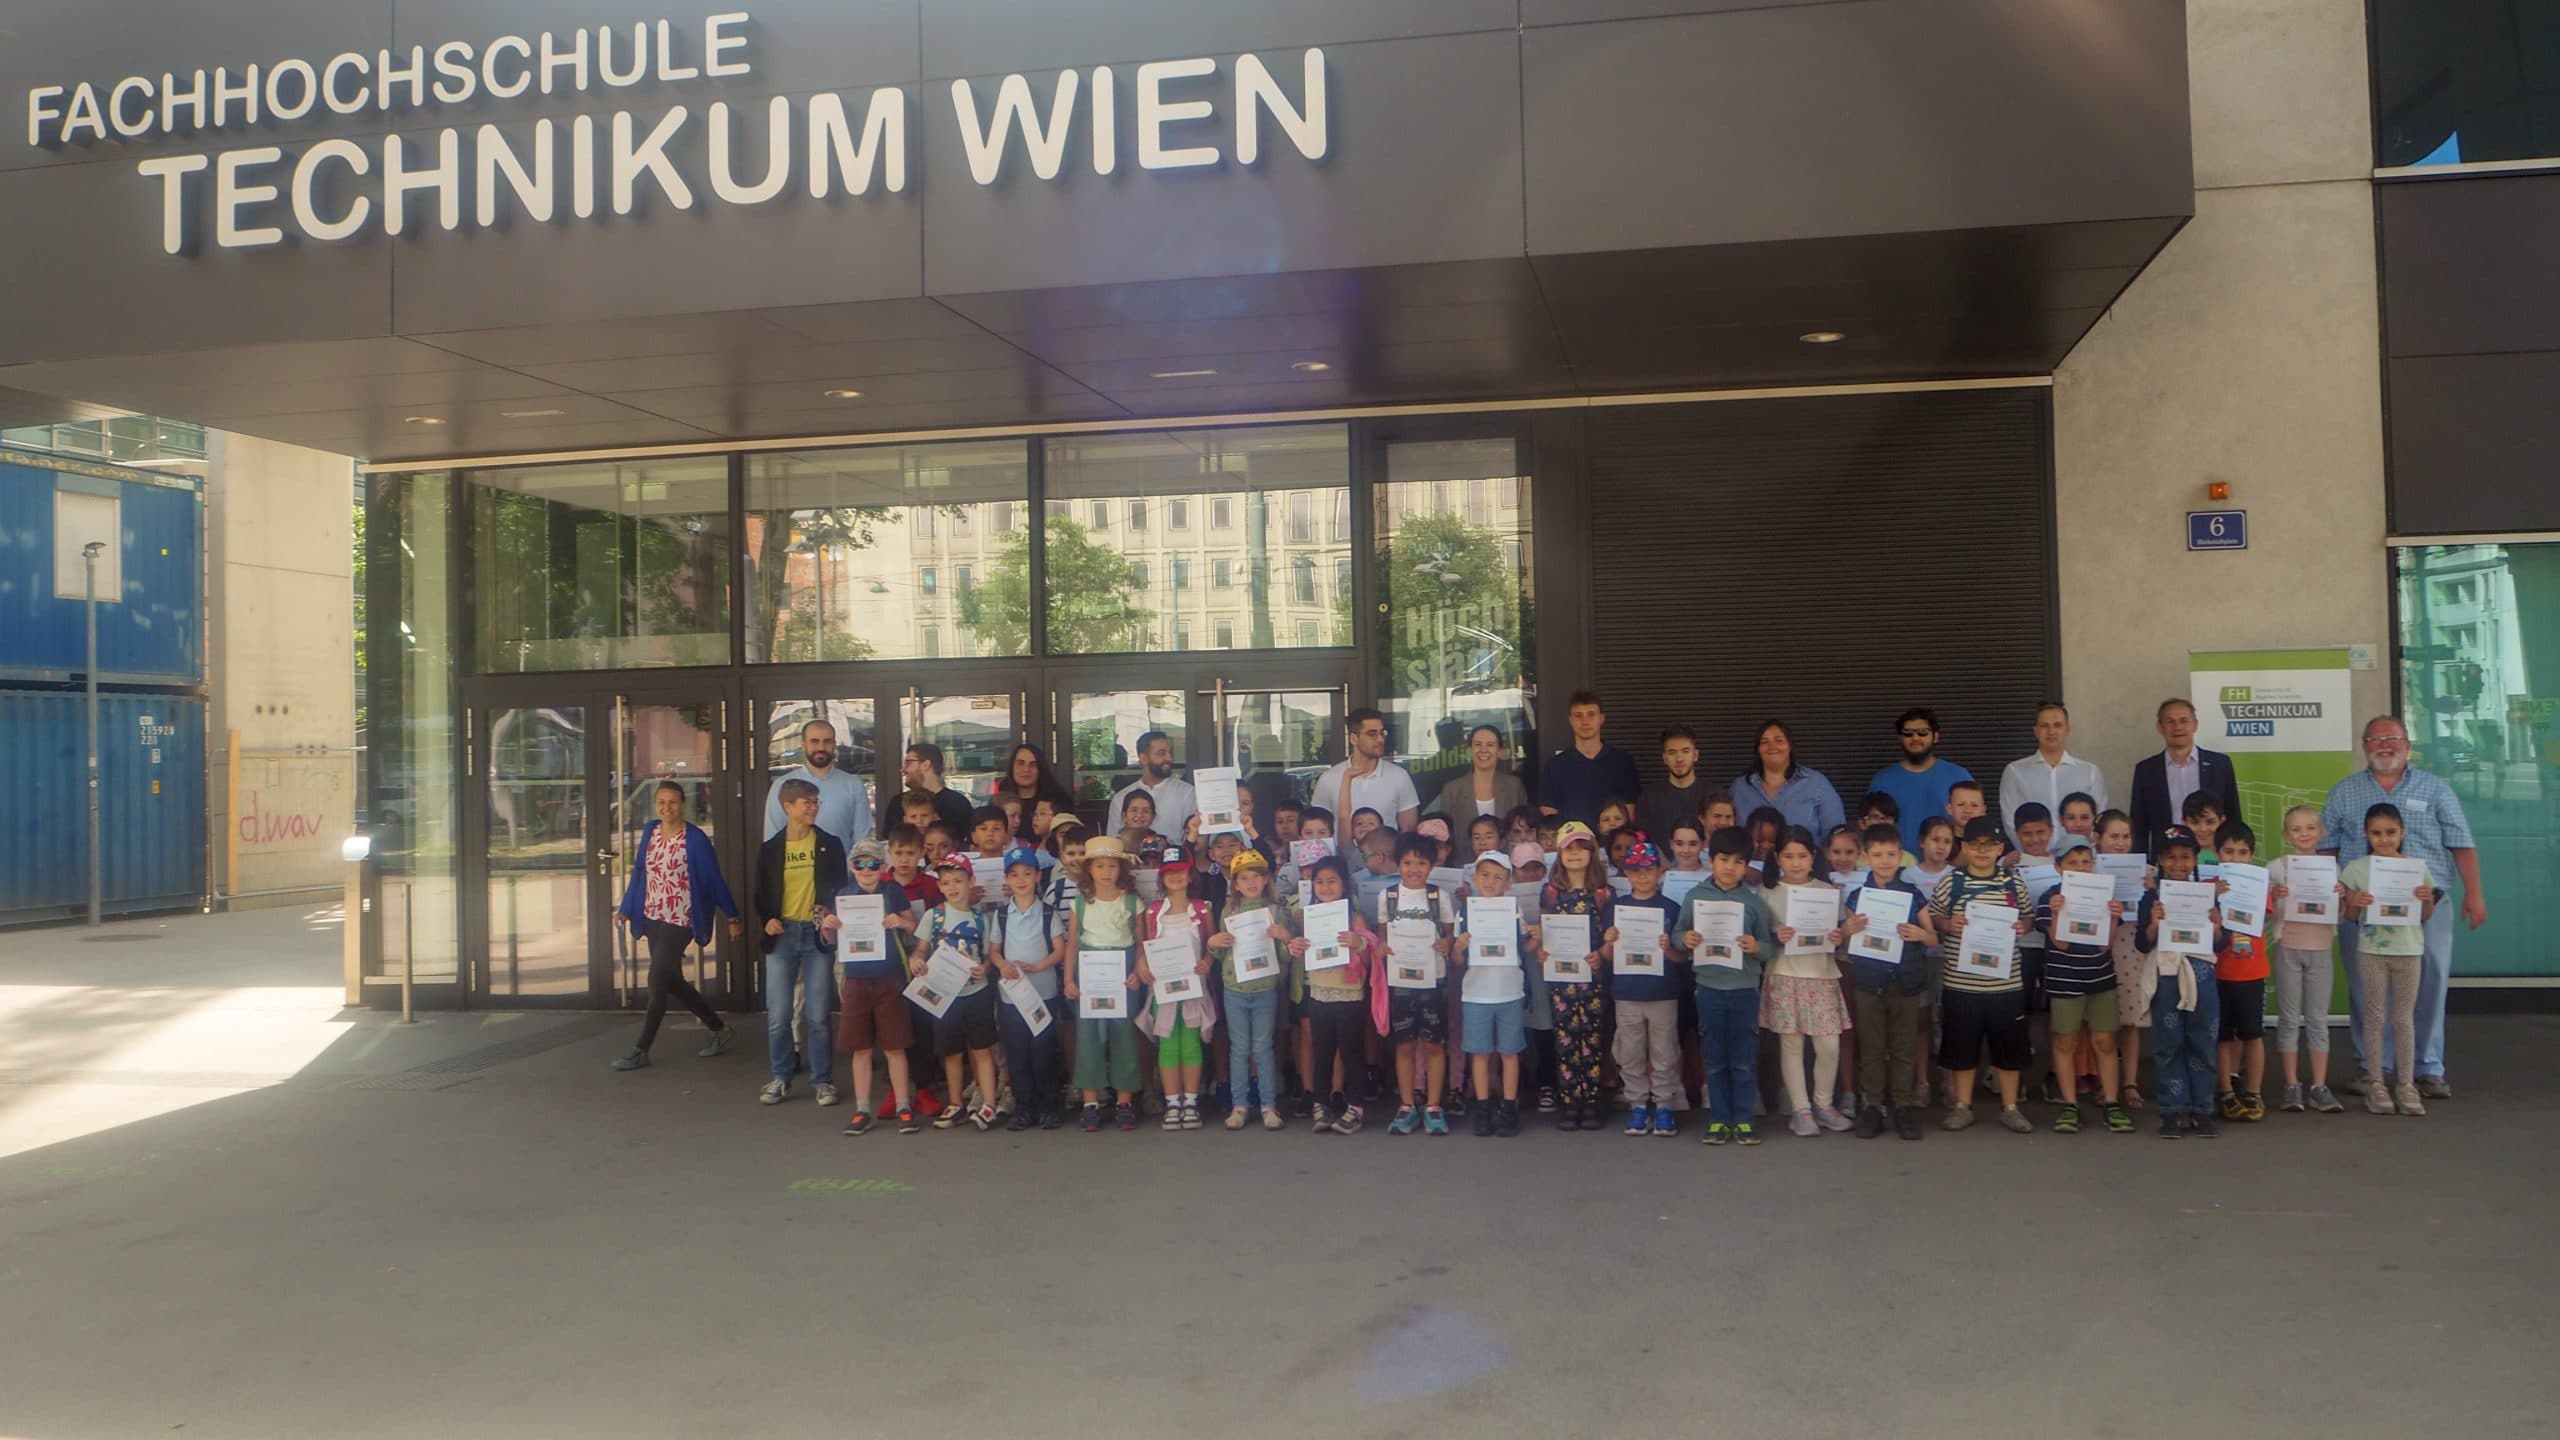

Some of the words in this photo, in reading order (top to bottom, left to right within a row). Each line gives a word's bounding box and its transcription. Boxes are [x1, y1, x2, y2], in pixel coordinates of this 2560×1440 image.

[30, 12, 750, 145] FACHHOCHSCHULE
[139, 87, 904, 253] TECHNIKUM
[951, 48, 1326, 184] WIEN
[2210, 516, 2225, 537] 6
[2227, 688, 2247, 700] FH
[2229, 704, 2317, 718] TECHNIKUM
[2231, 722, 2270, 735] WIEN
